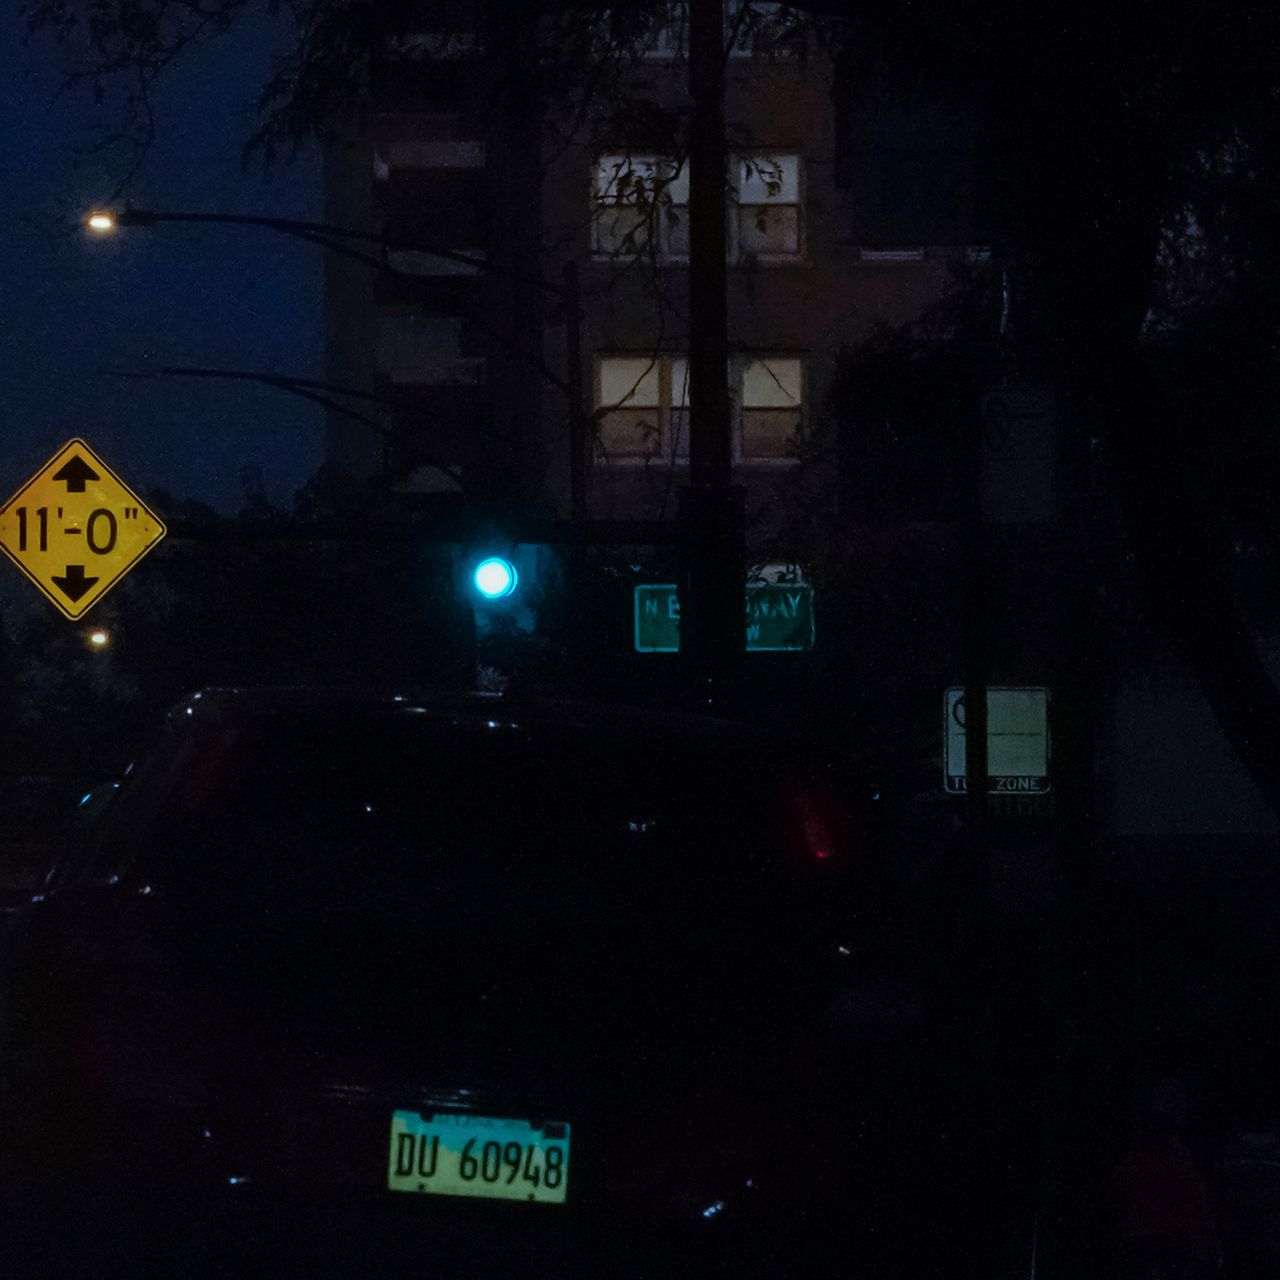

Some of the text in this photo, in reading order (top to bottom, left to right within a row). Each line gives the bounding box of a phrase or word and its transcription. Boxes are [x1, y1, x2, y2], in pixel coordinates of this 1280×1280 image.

[16, 507, 138, 555] 11'-0"
[645, 599, 658, 616] N
[995, 776, 1041, 791] ZONE
[395, 1133, 563, 1189] DU 60948
